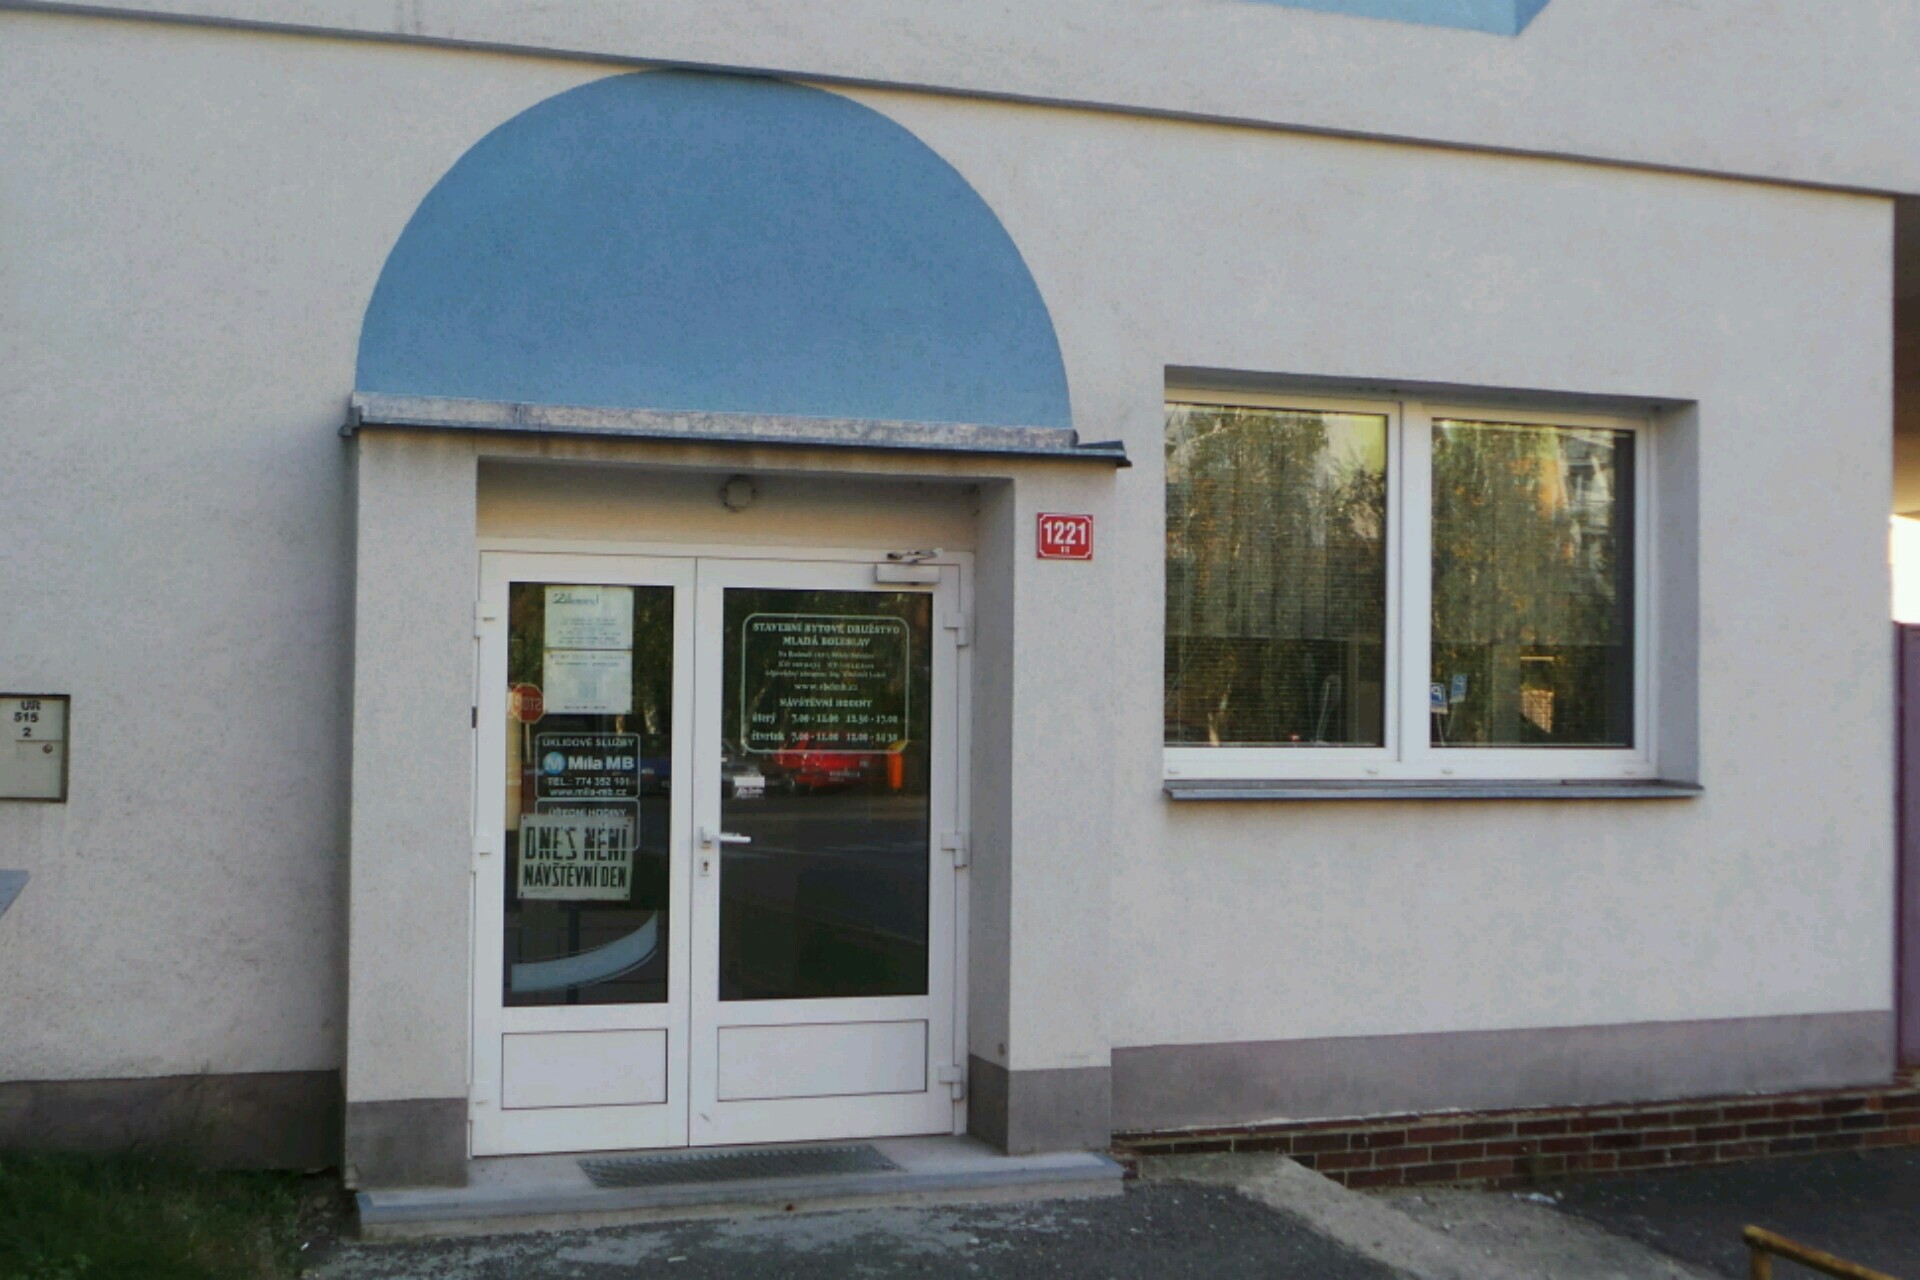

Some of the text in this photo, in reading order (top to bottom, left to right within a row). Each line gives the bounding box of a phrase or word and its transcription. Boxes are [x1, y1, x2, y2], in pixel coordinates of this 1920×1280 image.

[1043, 520, 1086, 545] 1221
[753, 622, 801, 633] STAVEBNÍ
[847, 622, 900, 634] DRUŽSTVO
[782, 635, 871, 647] MLADÁ BOLESLAV
[14, 711, 39, 722] 515
[22, 727, 31, 737] 2
[542, 736, 635, 747] ÚKLIDOVÉ SLUŽBY
[568, 755, 603, 771] Mila
[606, 755, 635, 771] MB
[588, 807, 626, 816] HODINY
[525, 824, 629, 861] DNES NENÍ
[523, 862, 627, 888] NÁVŠTĚVNÍ DEN
